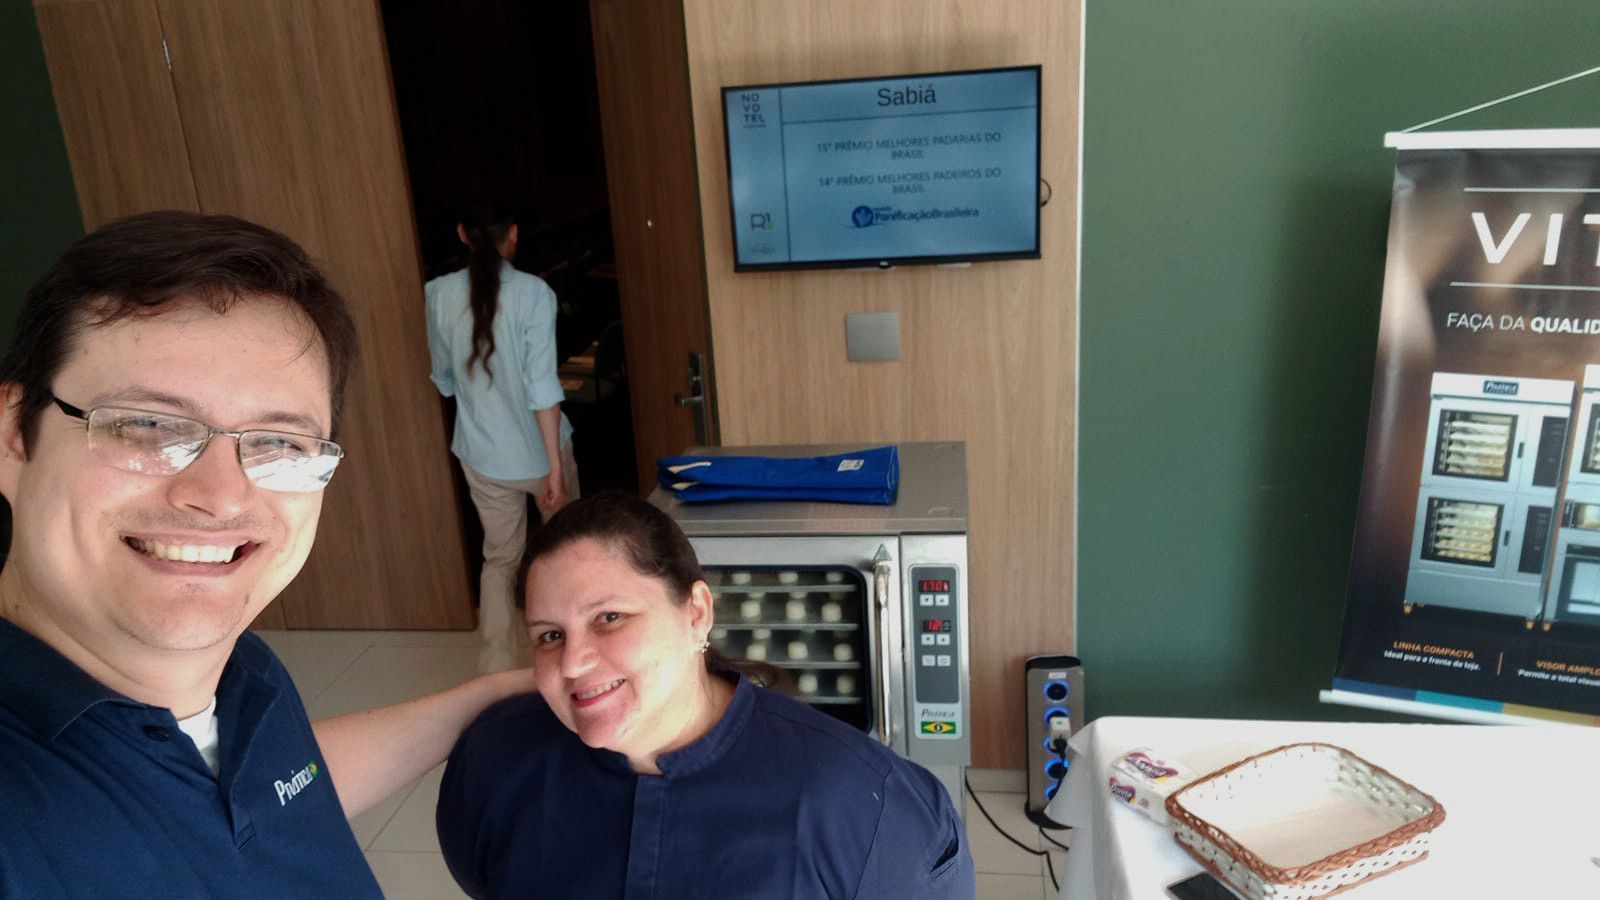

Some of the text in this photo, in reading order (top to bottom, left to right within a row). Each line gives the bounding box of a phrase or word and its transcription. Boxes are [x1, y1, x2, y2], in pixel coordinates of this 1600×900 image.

[741, 93, 760, 102] NO
[877, 84, 936, 106] Sabiá
[743, 103, 761, 112] VO
[743, 114, 766, 123] TEL
[876, 136, 929, 149] MELHORES
[932, 133, 982, 145] PADARIAS
[984, 131, 1001, 142] DO
[891, 150, 925, 160] BRASIL
[877, 171, 930, 184] MELHORES
[984, 167, 1001, 178] DO
[891, 184, 926, 194] BRASIL
[1446, 312, 1494, 333] FAÇA
[1500, 315, 1526, 331] DA
[1393, 641, 1474, 659] LINHA COMPACTA
[1384, 650, 1403, 660] Ideal
[1403, 654, 1421, 663] para
[1428, 656, 1452, 667] frente
[1453, 660, 1463, 668] de
[1536, 660, 1566, 672] VISOR
[1518, 668, 1550, 680] Permite
[1557, 674, 1577, 683] total
